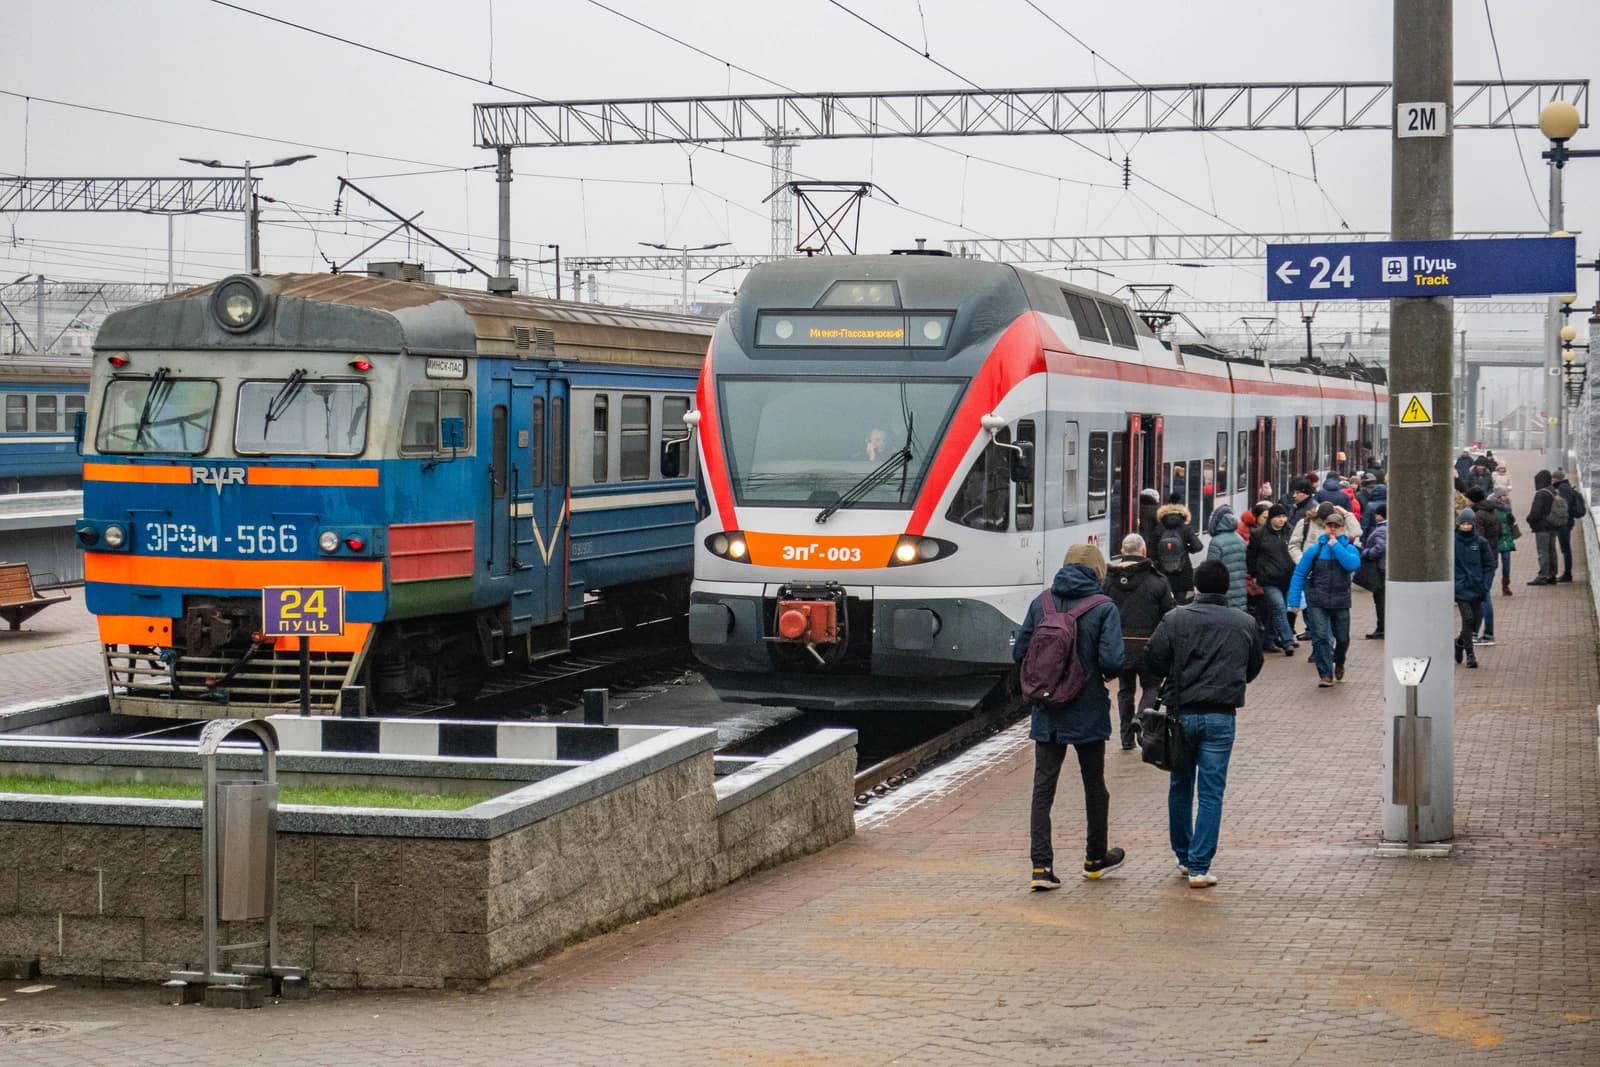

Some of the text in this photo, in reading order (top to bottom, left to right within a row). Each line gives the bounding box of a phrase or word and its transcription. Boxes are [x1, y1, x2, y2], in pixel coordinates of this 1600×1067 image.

[1309, 255, 1355, 289] 24
[1413, 255, 1457, 273] Пуць
[1414, 274, 1449, 286] Track
[191, 466, 246, 496] RVR
[280, 589, 327, 619] 24
[279, 620, 329, 633] ПУЦЬ
